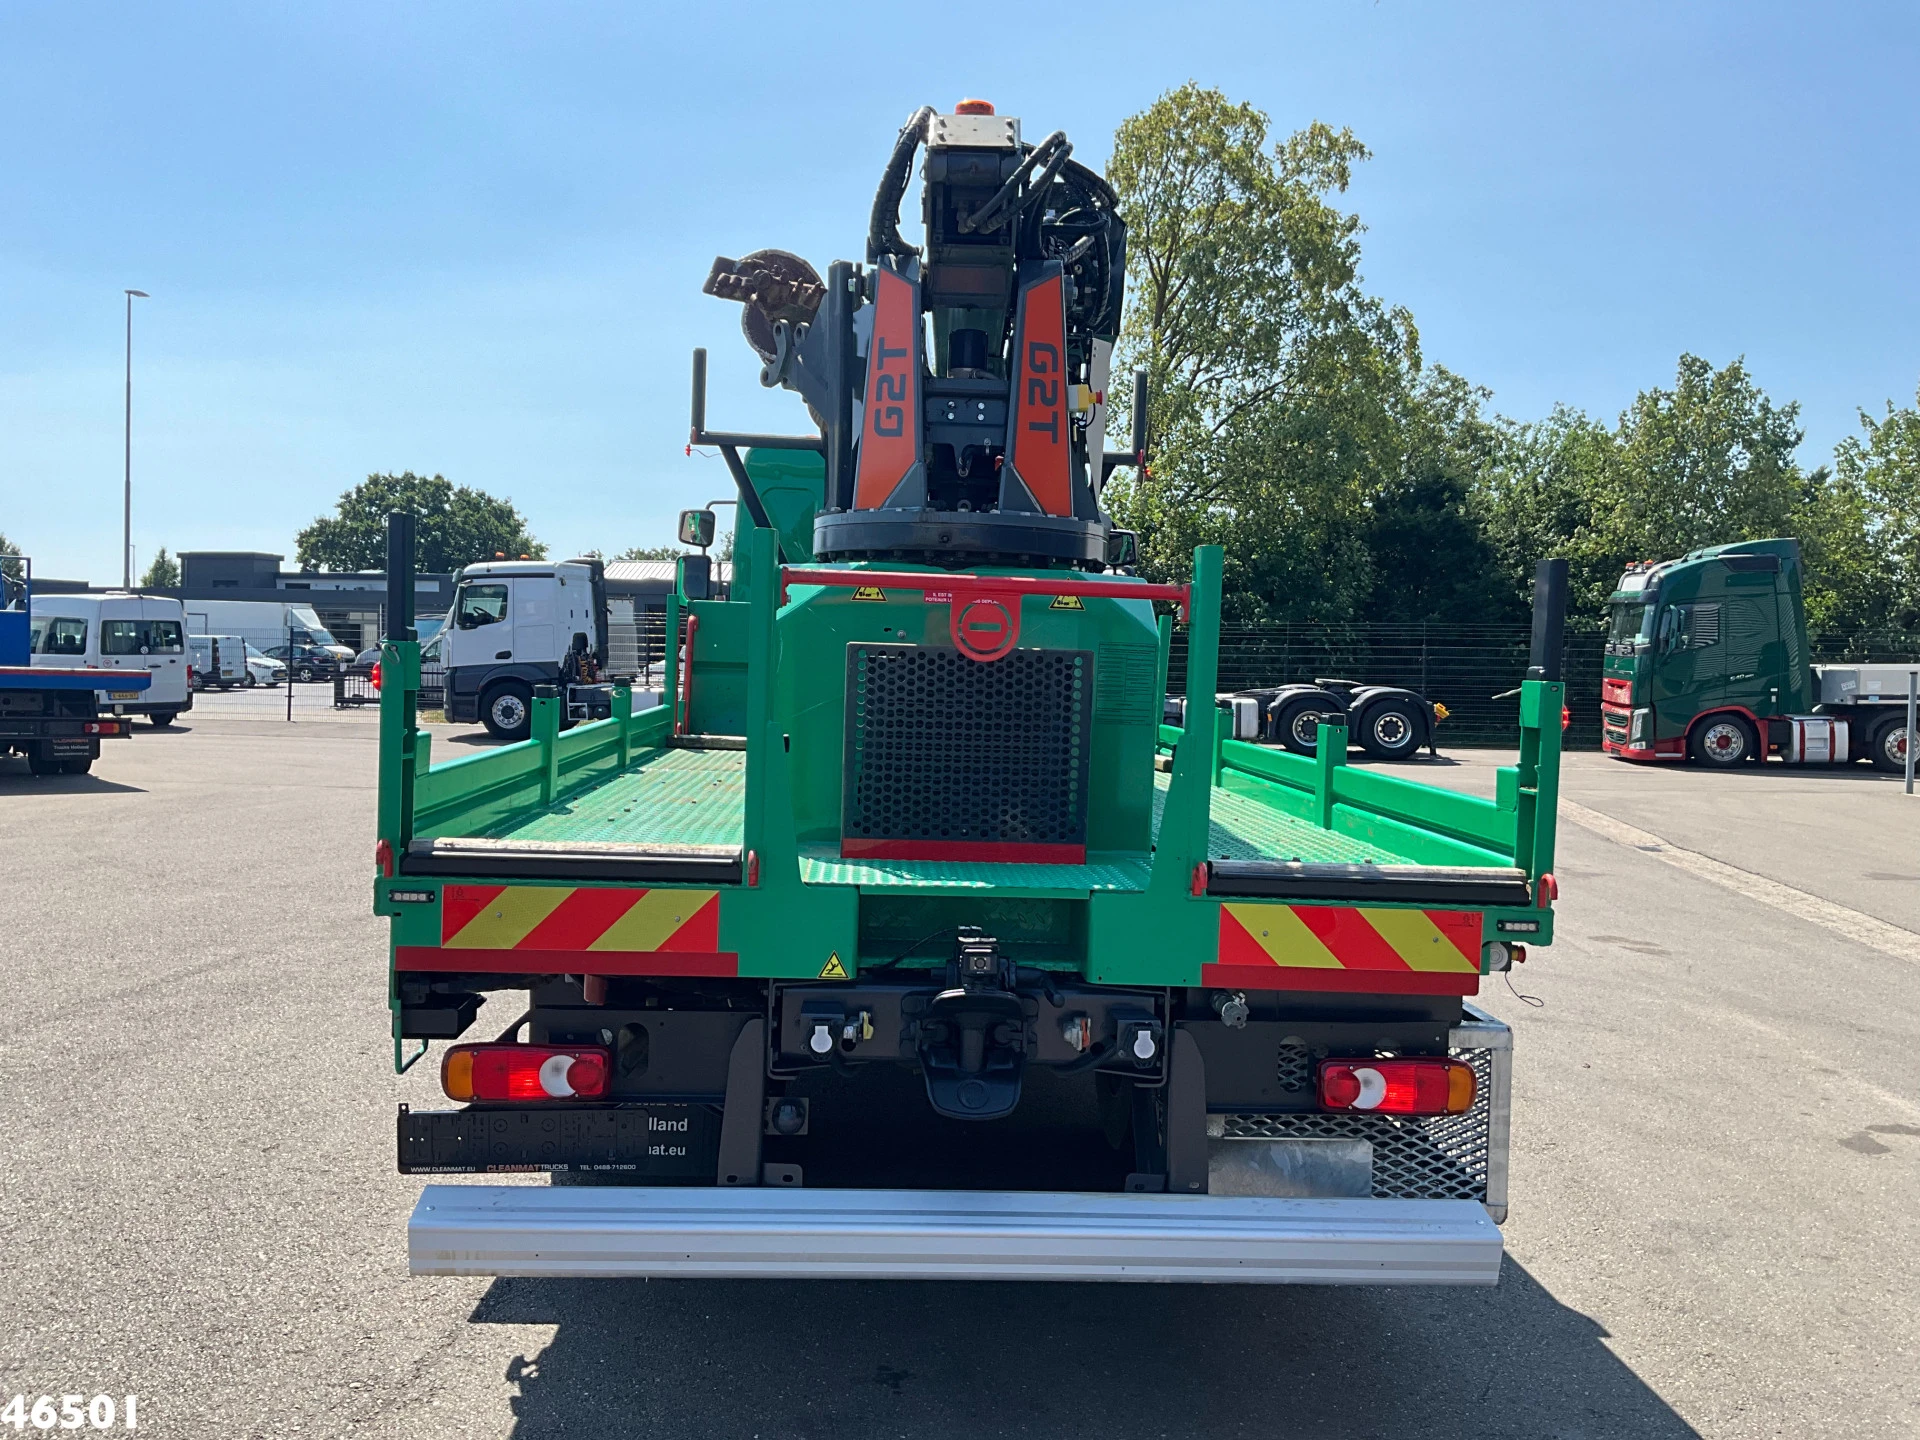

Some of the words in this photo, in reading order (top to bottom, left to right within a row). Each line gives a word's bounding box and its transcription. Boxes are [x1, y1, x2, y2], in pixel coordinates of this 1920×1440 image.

[874, 337, 907, 437] G2T
[1028, 341, 1059, 444] G2T
[648, 1117, 688, 1131] lland
[648, 1144, 686, 1155] at.eu
